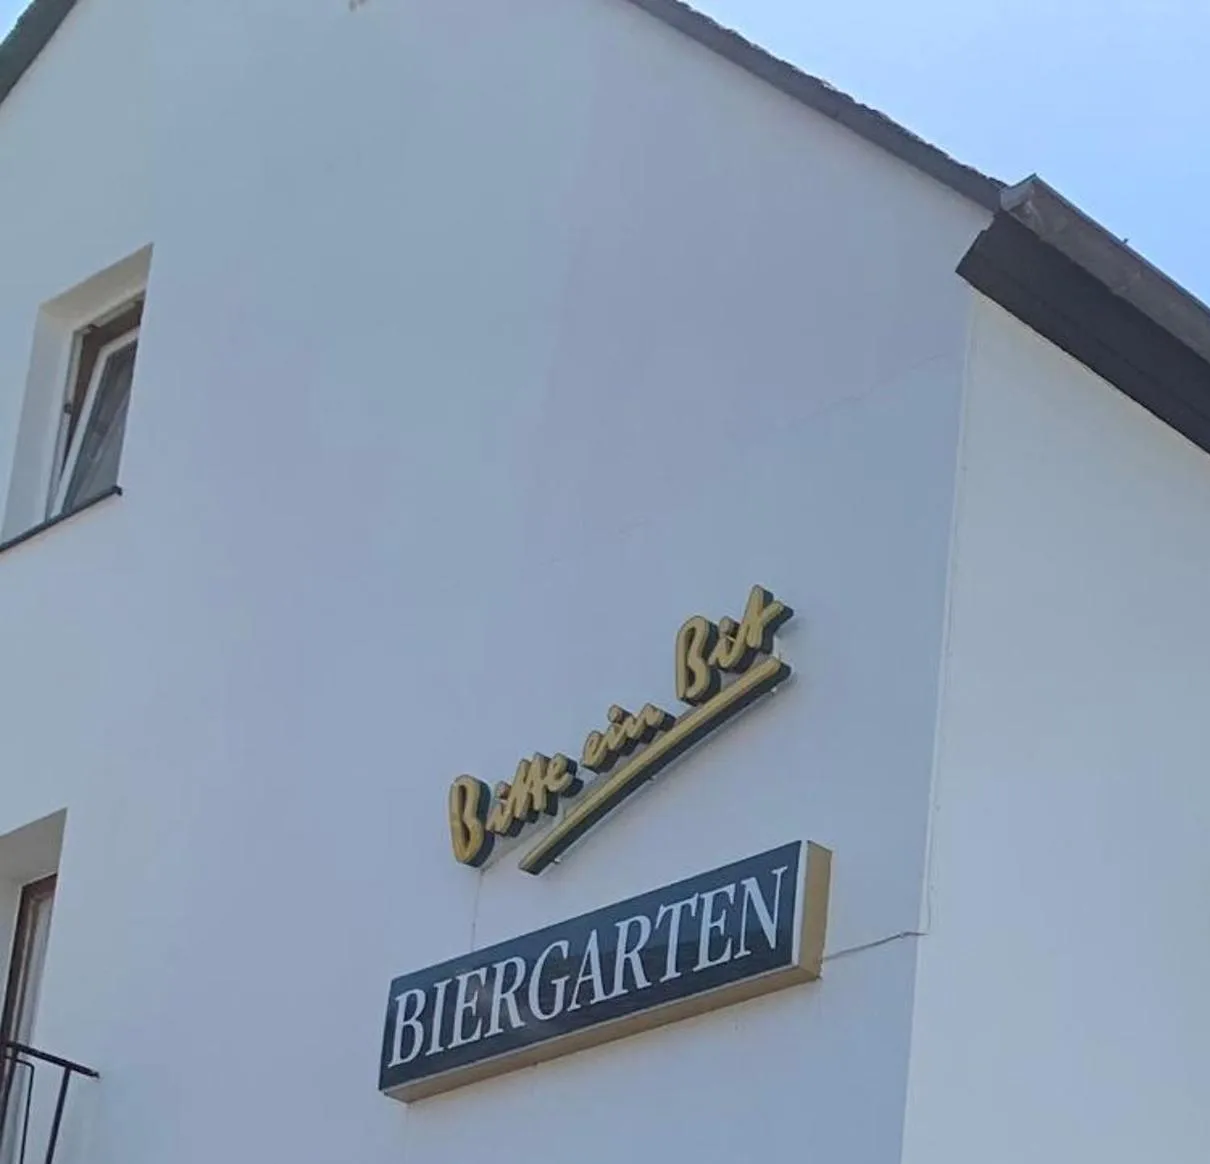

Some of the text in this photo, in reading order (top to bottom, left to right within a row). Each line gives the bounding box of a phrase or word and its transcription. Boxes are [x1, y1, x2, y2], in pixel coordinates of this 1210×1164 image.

[449, 585, 794, 868] Bitte ein Bit
[387, 866, 788, 1068] BIERGARTEN
